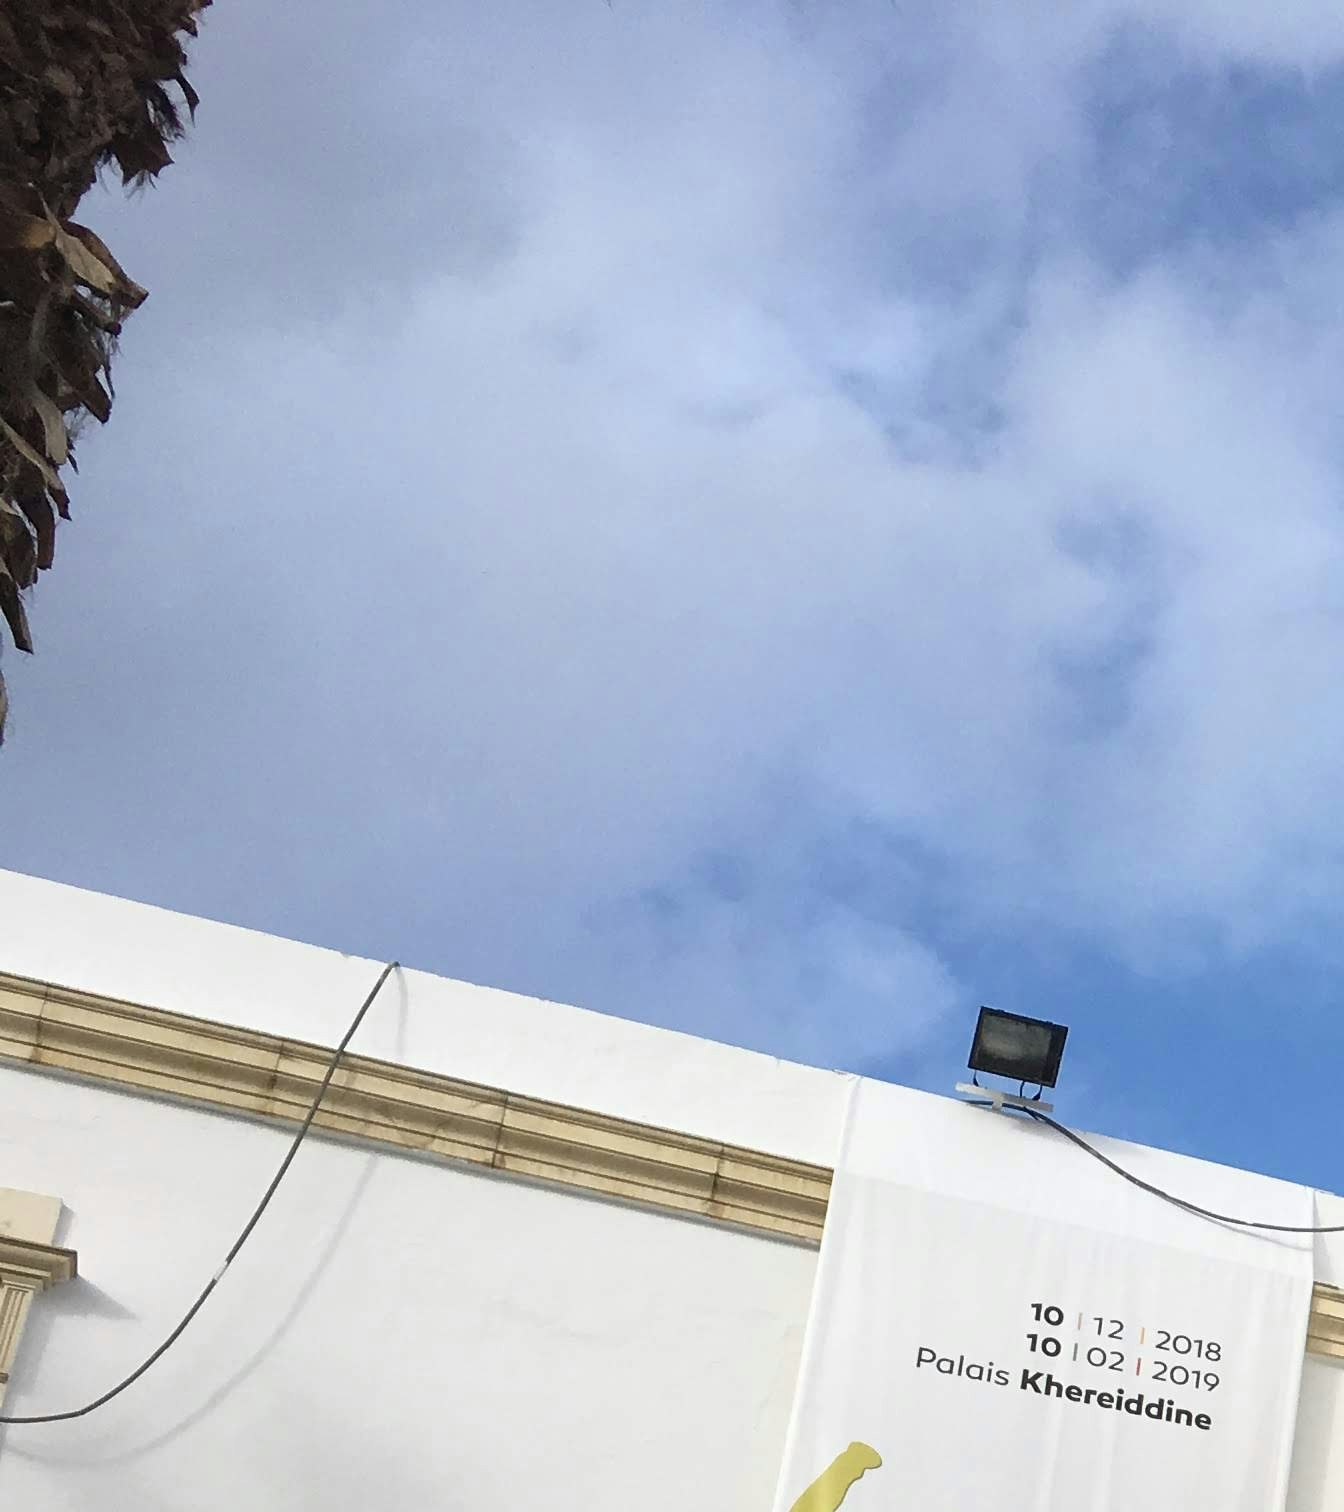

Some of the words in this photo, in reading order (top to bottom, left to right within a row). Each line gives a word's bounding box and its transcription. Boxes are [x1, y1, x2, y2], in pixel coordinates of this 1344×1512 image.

[1030, 1303, 1065, 1327] 10
[1093, 1317, 1125, 1341] 12
[1154, 1329, 1222, 1362] 2018
[915, 1346, 1010, 1386] Palais
[1019, 1368, 1213, 1431] Khereiddine
[1025, 1333, 1062, 1358] 10
[1086, 1346, 1125, 1372] 02
[1151, 1360, 1220, 1392] 2019
